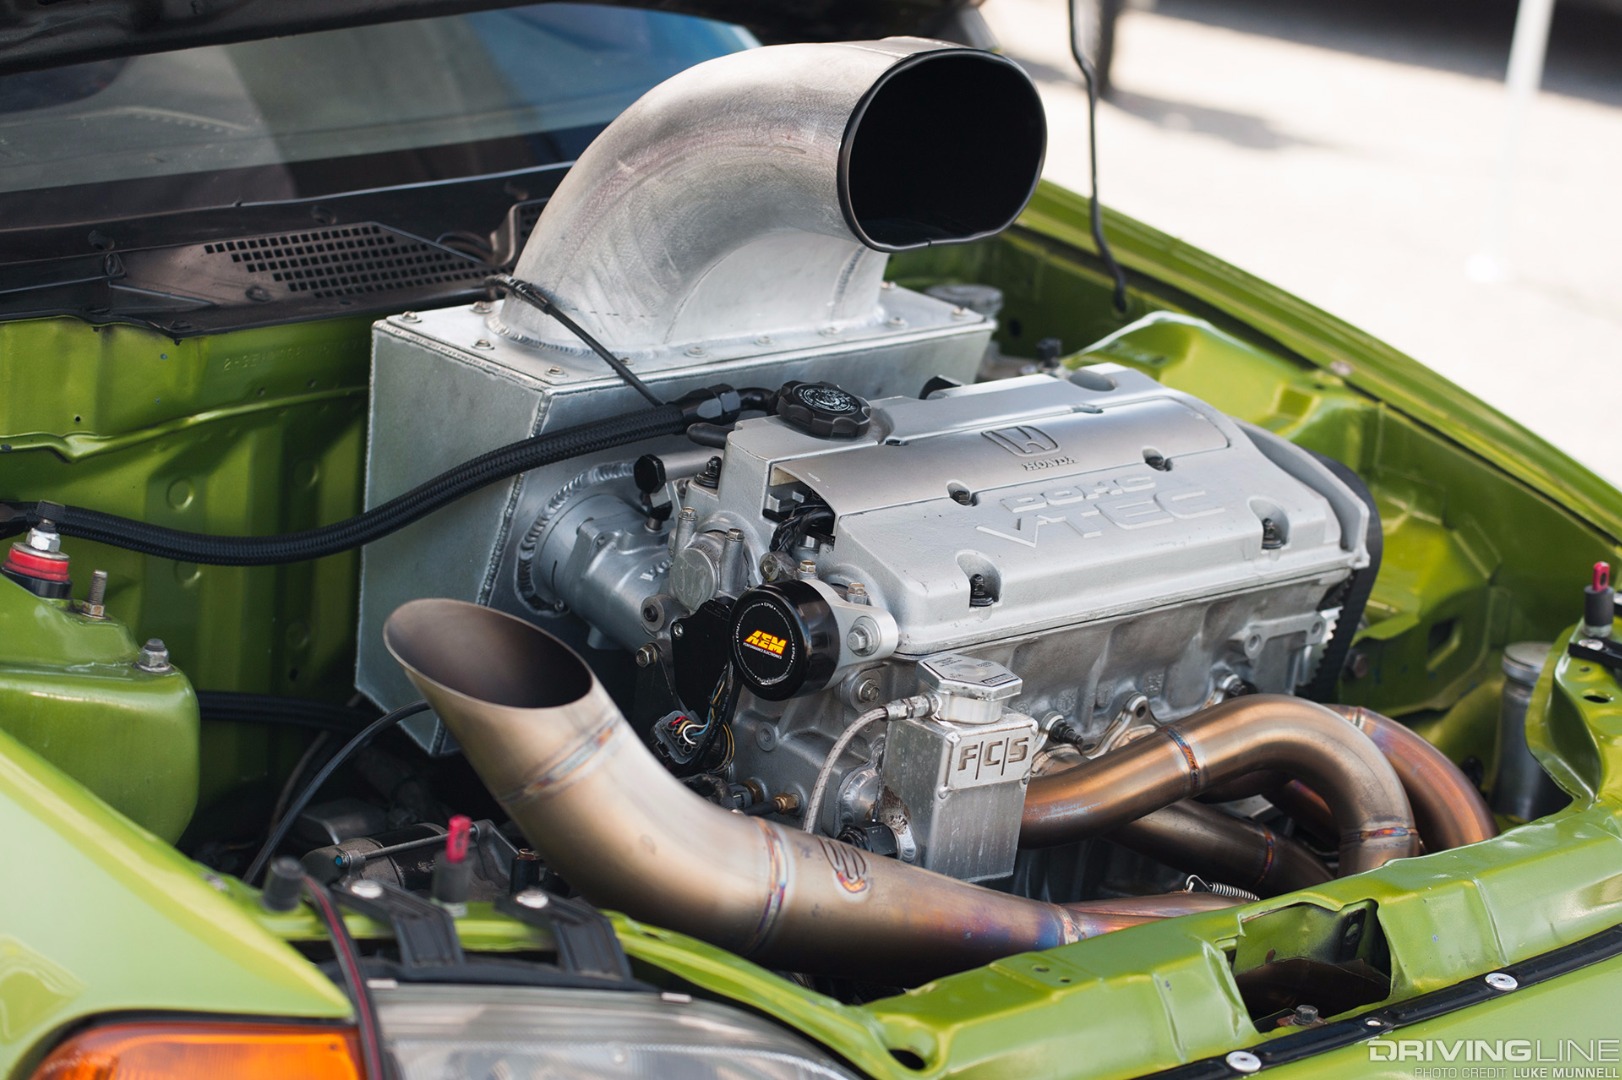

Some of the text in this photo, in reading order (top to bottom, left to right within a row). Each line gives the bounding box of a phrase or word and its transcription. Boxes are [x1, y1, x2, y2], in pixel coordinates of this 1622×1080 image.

[1021, 456, 1079, 471] HONDA
[1000, 475, 1156, 513] DOHC
[976, 489, 1225, 548] VTEC
[744, 629, 787, 656] AEM
